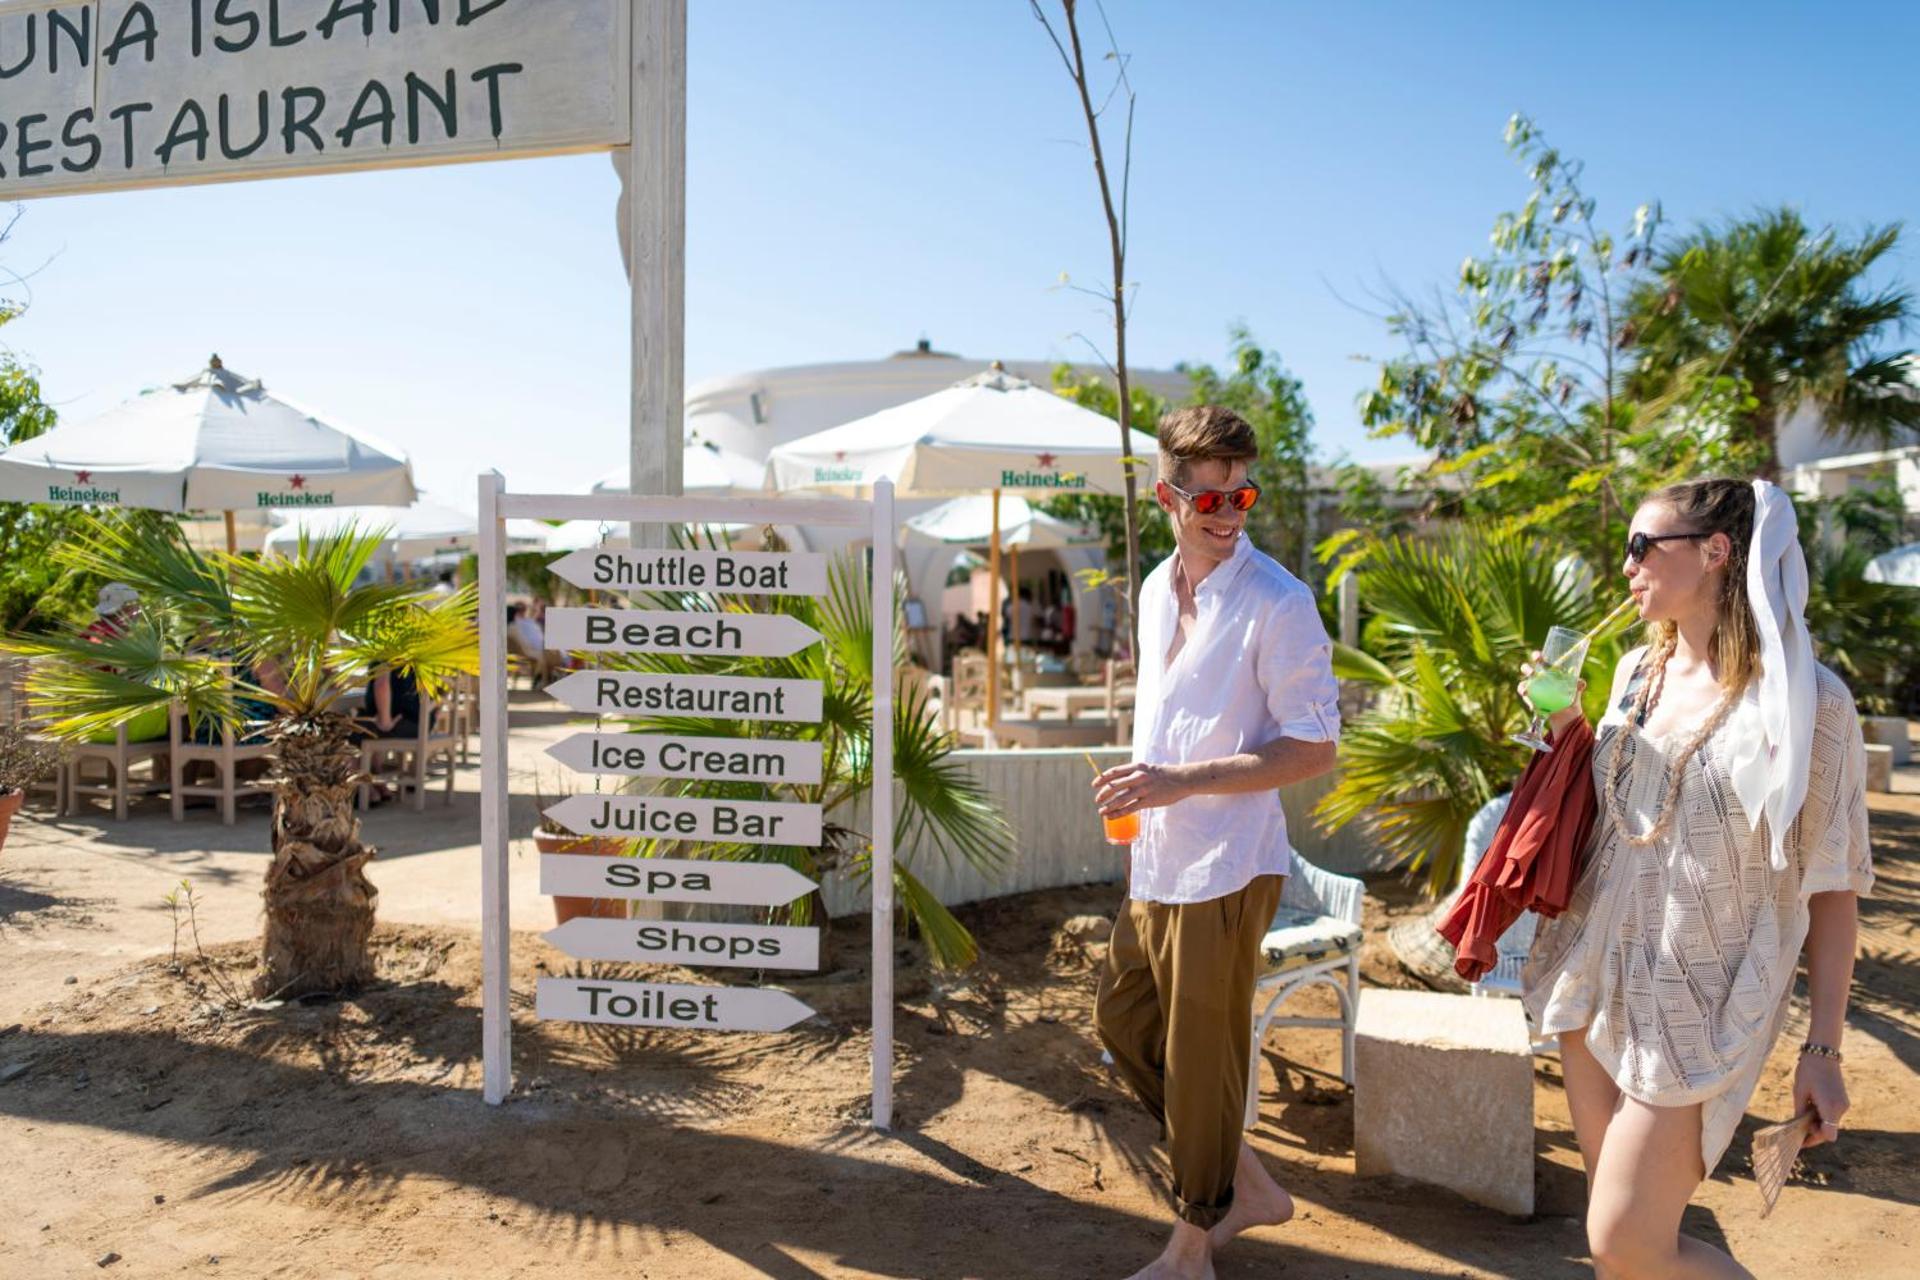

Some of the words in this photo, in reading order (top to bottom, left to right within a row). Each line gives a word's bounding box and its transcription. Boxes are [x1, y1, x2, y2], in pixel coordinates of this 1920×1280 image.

[0, 62, 523, 179] ESTAURANT
[48, 485, 120, 503] Heineken
[257, 491, 335, 507] Heineken
[593, 554, 706, 587] Shuttle
[716, 557, 788, 589] Boat
[585, 615, 742, 649] Beach
[597, 678, 785, 715] Restaurant
[592, 739, 646, 770] Ice
[658, 742, 785, 776] Cream
[590, 800, 698, 834] Juice
[712, 807, 784, 838] Bar
[605, 863, 712, 894] Spa
[636, 927, 781, 960] Shops
[577, 986, 719, 1023] Toilet
